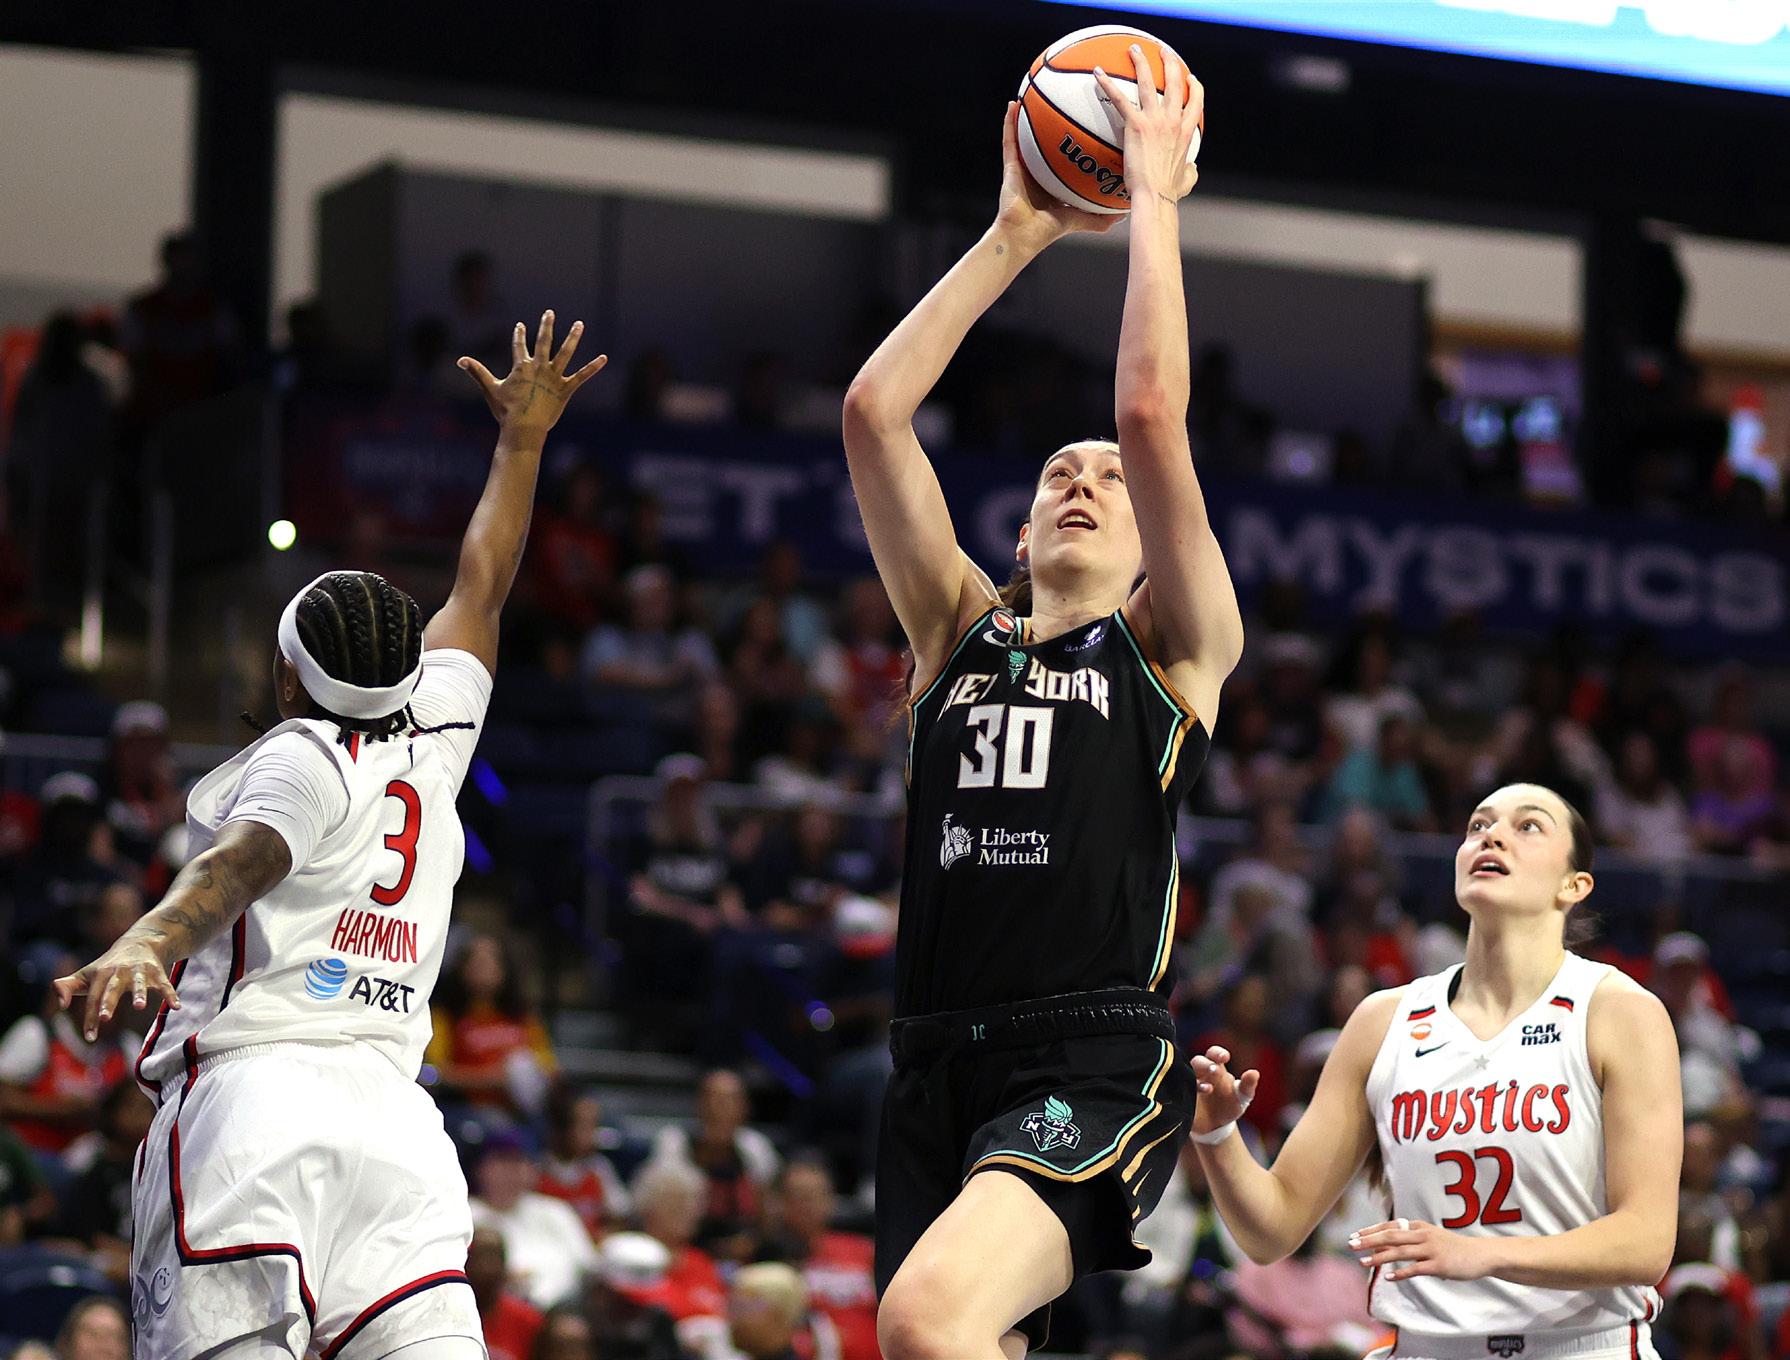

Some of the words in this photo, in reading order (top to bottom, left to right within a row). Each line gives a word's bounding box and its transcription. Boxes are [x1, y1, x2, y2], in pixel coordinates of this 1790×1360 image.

[1058, 132, 1132, 201] lson
[1228, 508, 1788, 634] MYSTICS
[1024, 655, 1110, 721] YORK
[957, 703, 1056, 789] 30
[369, 779, 422, 906] 3
[977, 847, 1050, 865] Mutual
[980, 828, 1051, 852] Liberty
[330, 908, 418, 964] HARMON
[348, 975, 415, 1013] AT&T
[1521, 1023, 1557, 1035] CAR
[1521, 1031, 1561, 1046] max
[1435, 1145, 1522, 1229] 32
